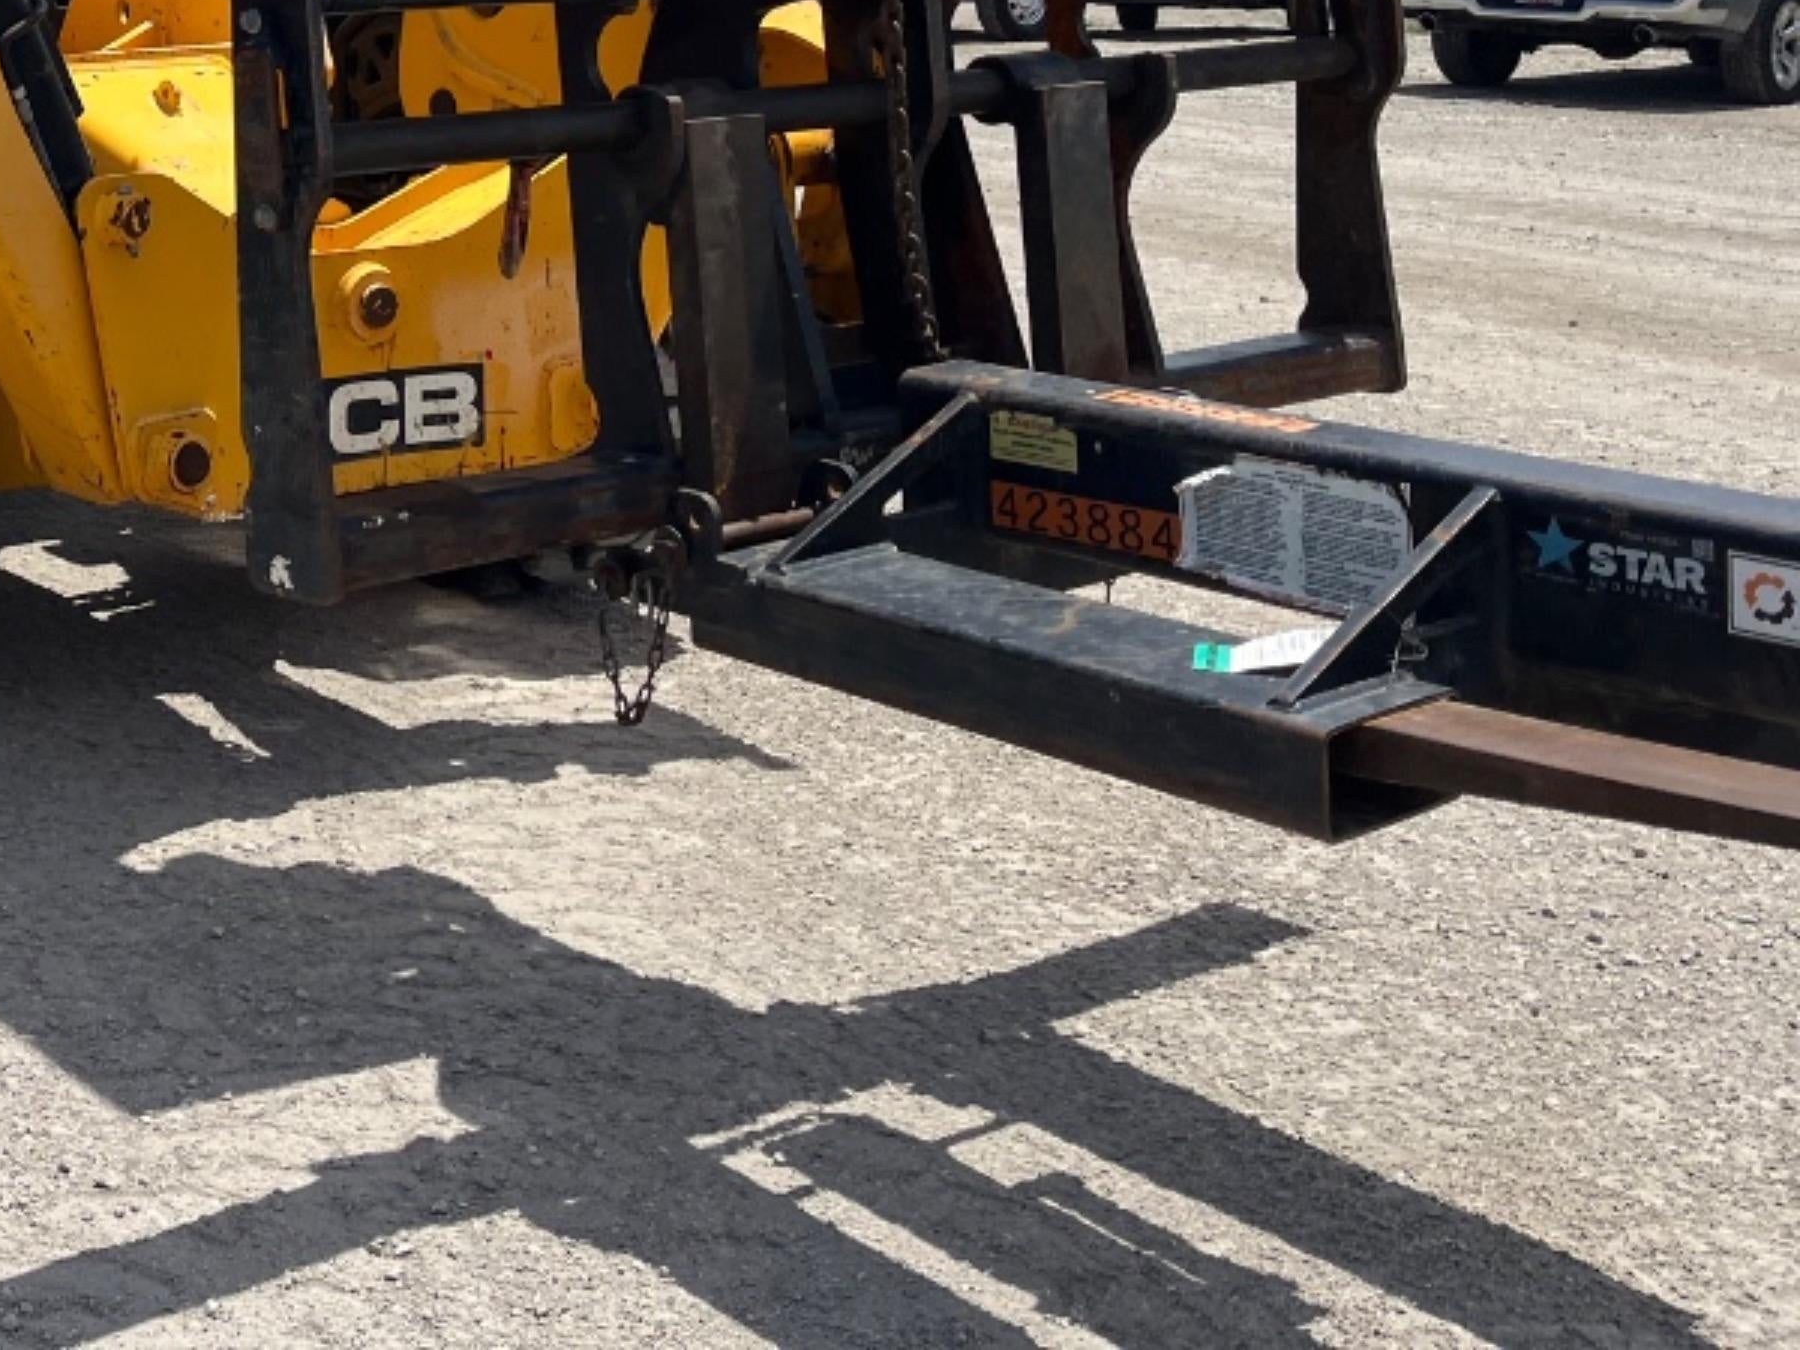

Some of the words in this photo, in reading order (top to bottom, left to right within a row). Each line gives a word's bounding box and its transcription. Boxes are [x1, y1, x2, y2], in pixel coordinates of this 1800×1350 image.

[328, 370, 479, 455] CB
[996, 487, 1177, 558] 423884
[1587, 540, 1706, 595] STAR
